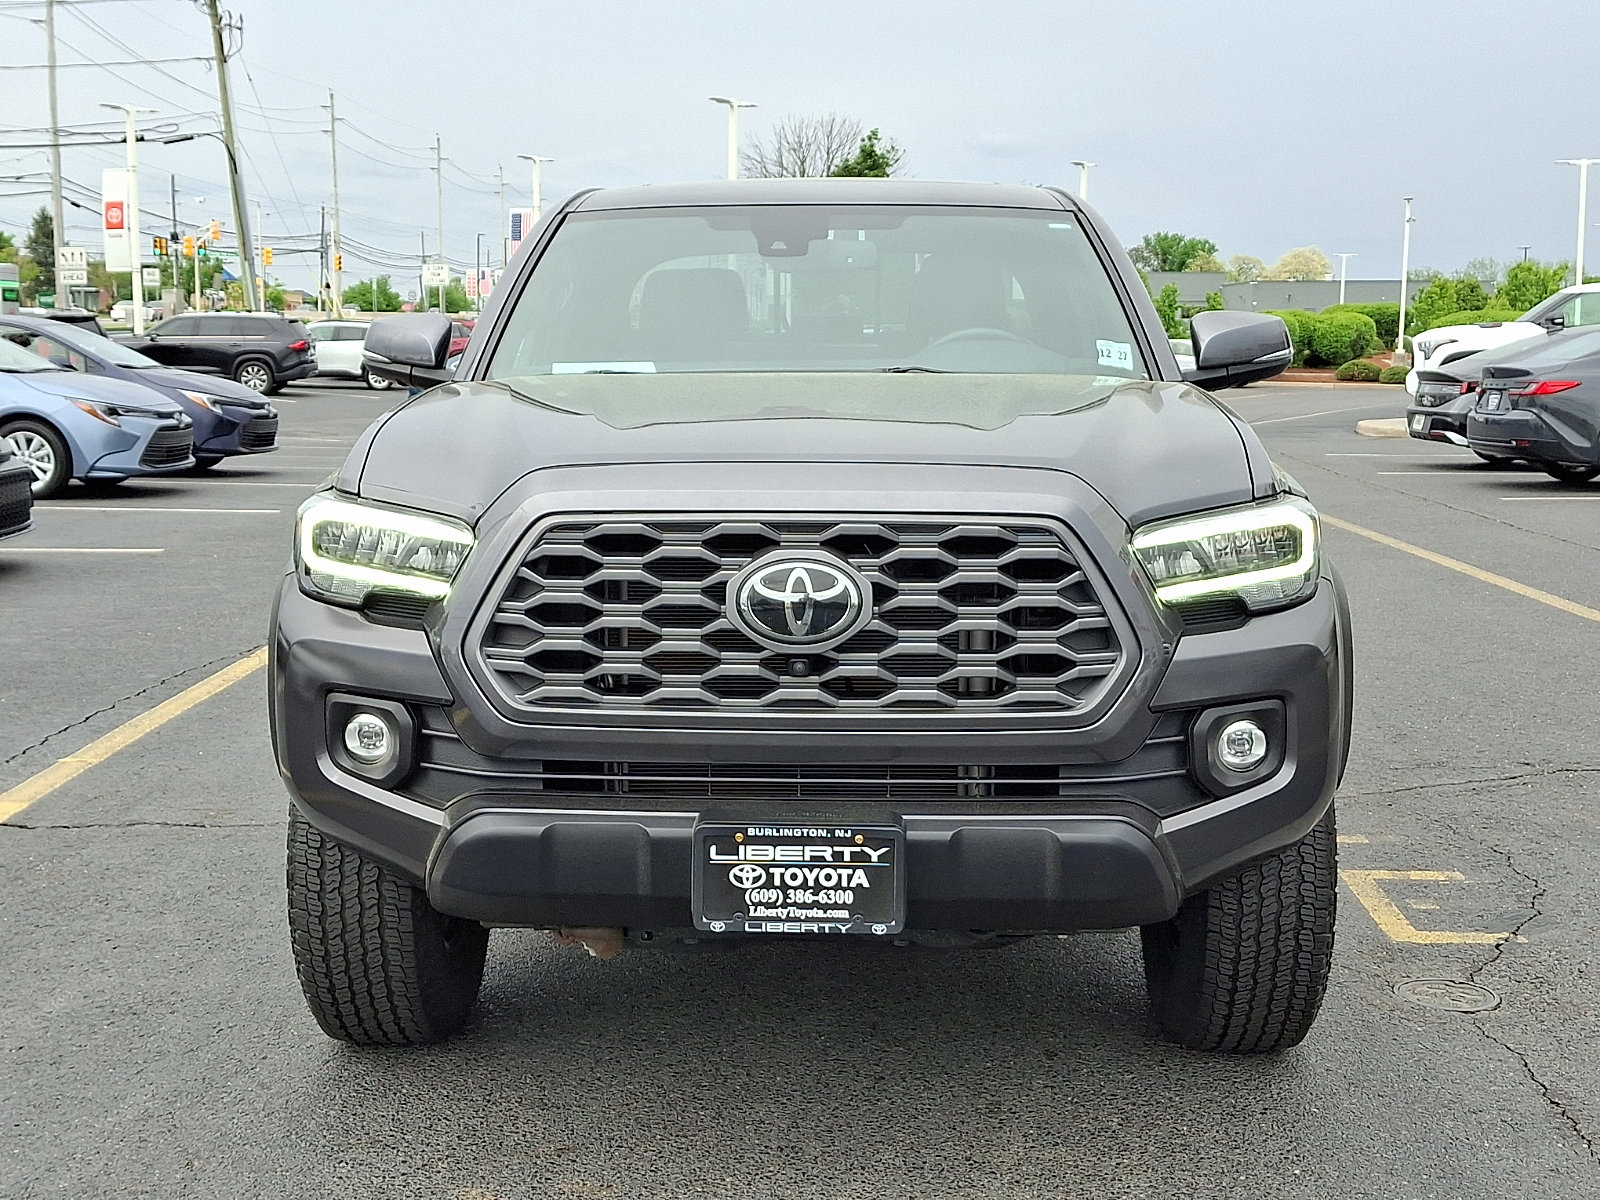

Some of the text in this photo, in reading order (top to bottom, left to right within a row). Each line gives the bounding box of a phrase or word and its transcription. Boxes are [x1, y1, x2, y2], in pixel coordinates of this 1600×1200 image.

[1100, 349, 1111, 358] 12
[834, 829, 852, 838] NJ
[709, 844, 890, 862] LIBERTY
[769, 867, 870, 888] TOYOTA
[744, 888, 854, 905] (609) 386-6300
[748, 905, 850, 919] LibertyToyota.com
[744, 921, 853, 934] LIBERTY
